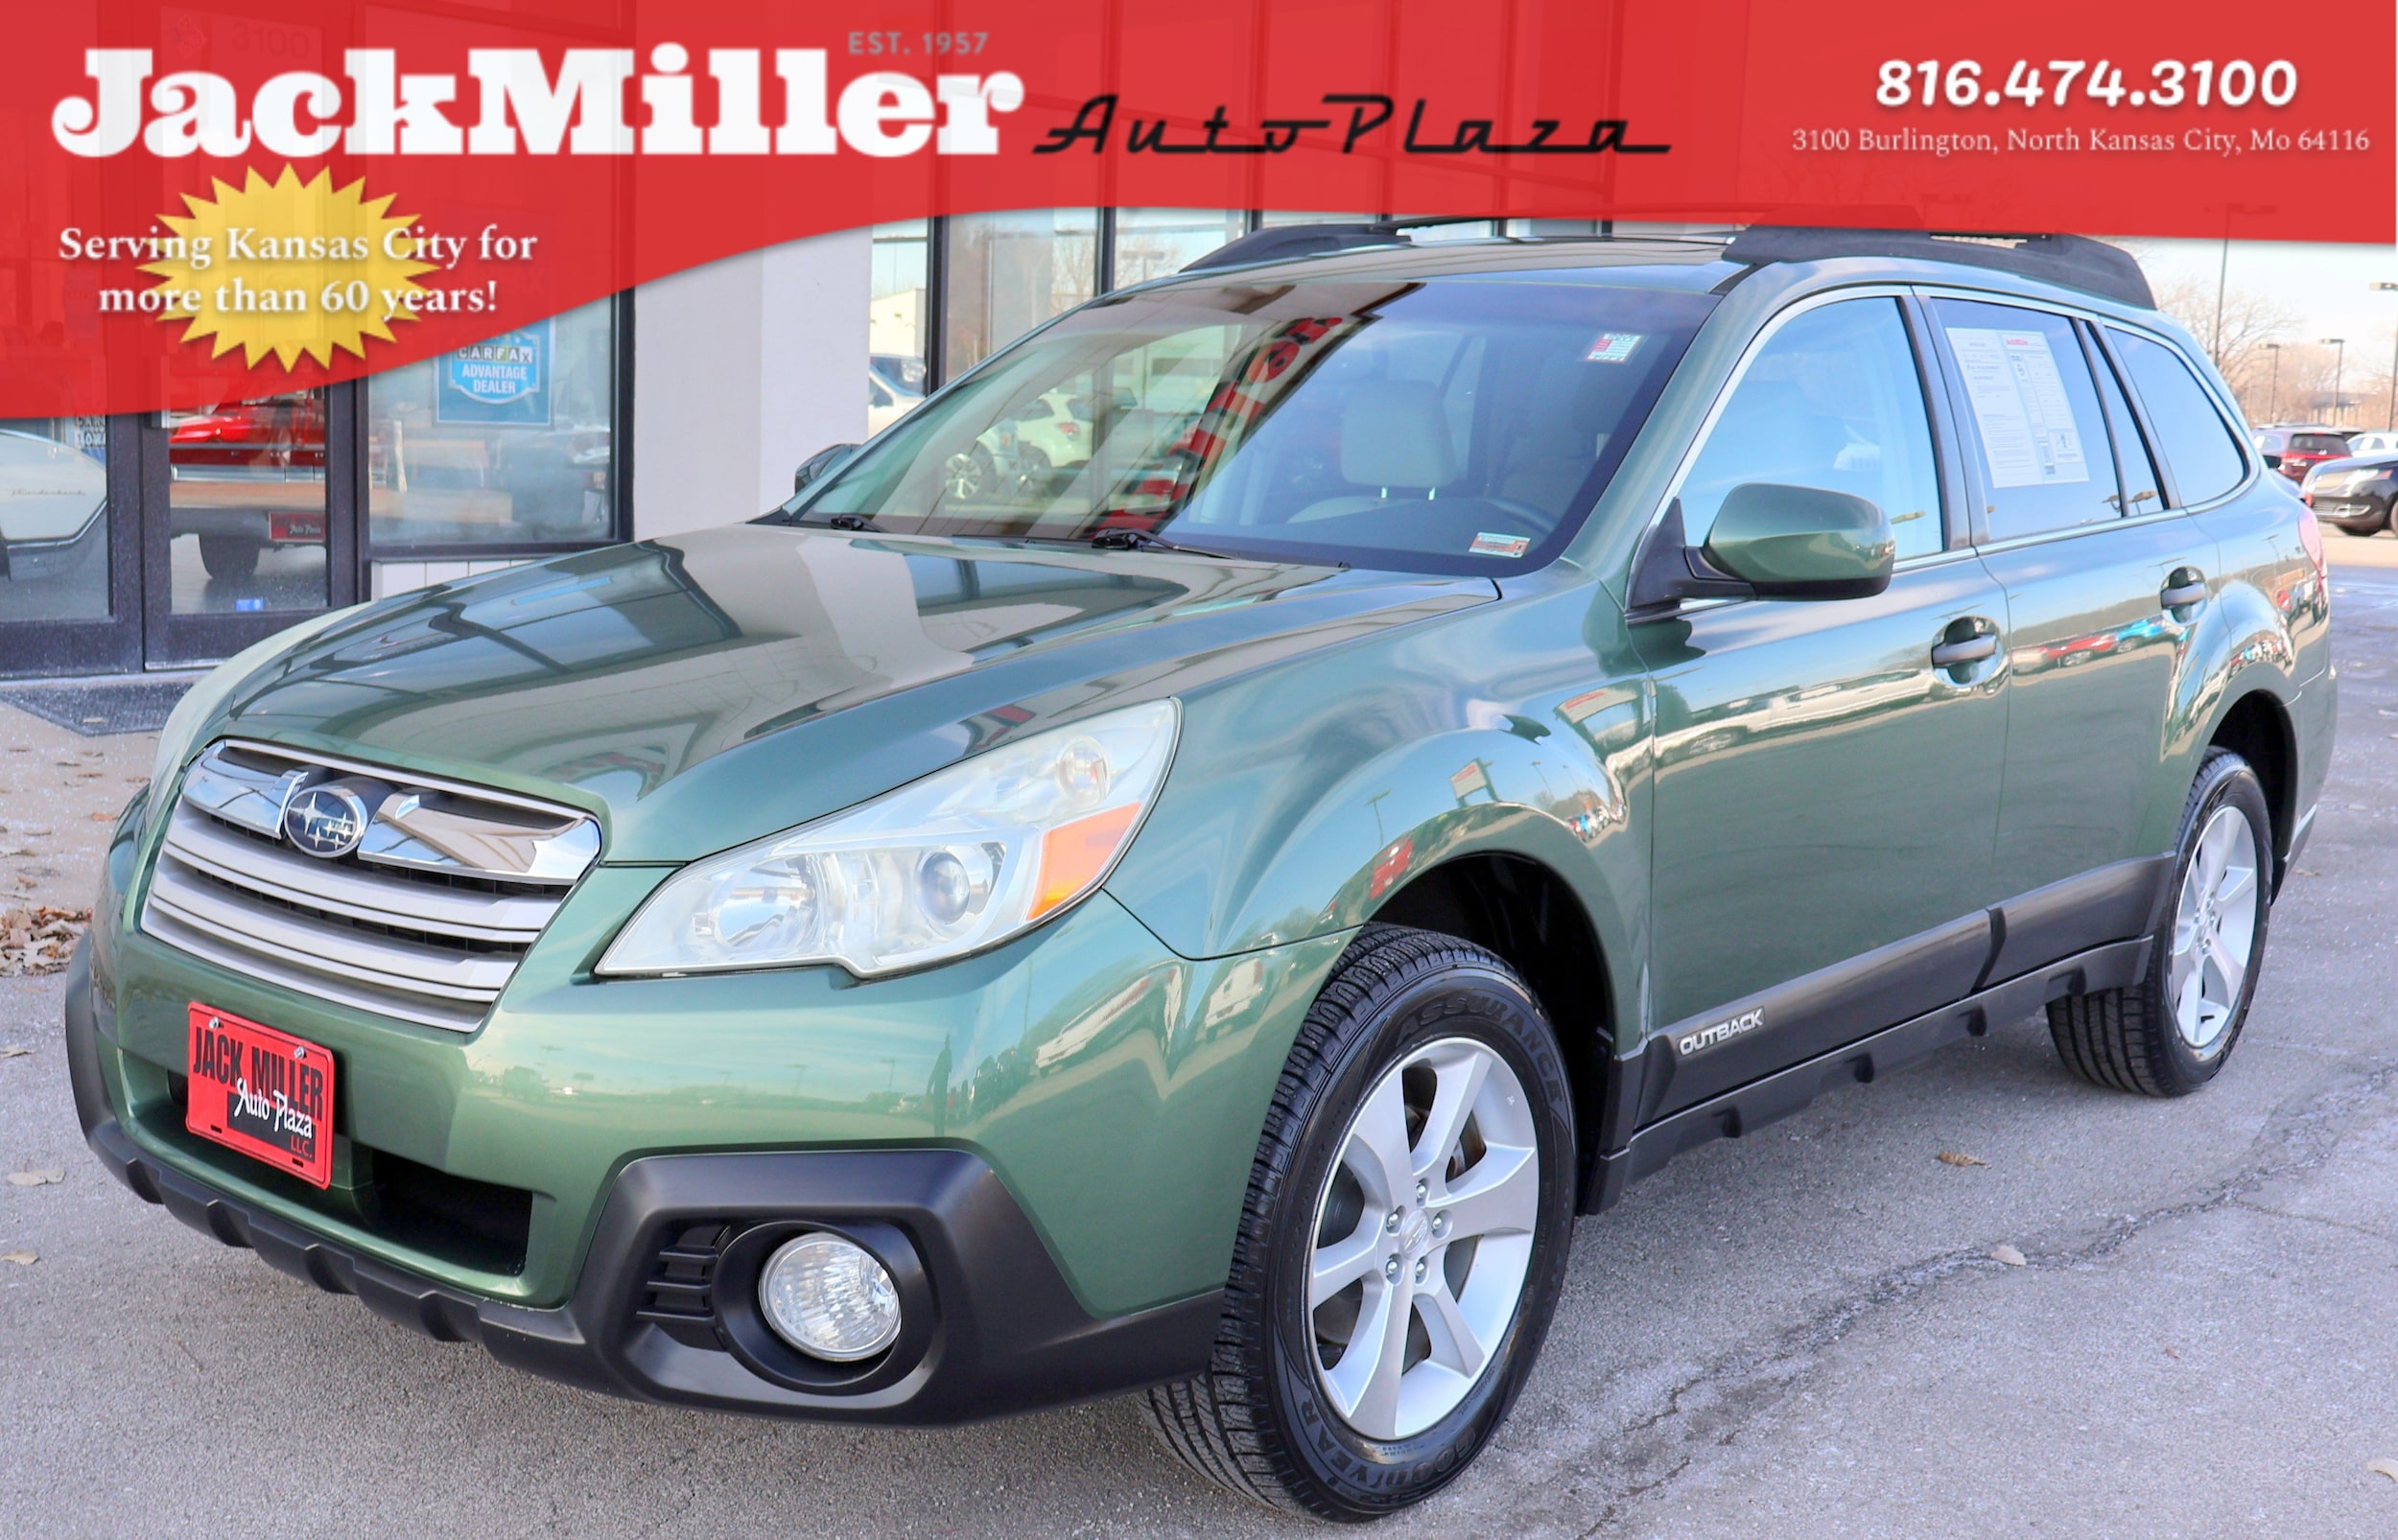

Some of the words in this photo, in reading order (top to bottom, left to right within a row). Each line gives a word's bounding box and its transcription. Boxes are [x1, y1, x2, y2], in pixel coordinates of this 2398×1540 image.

[457, 345, 533, 363] CARFAX
[461, 363, 528, 380] ADVANTAGE
[473, 379, 517, 394] DEALER
[1396, 994, 1563, 1103] ASSURANCE
[1679, 1008, 1764, 1056] OUTBACK
[193, 1026, 244, 1088] JACK
[251, 1046, 323, 1122] MILLER
[234, 1077, 270, 1121] Auto
[273, 1089, 313, 1139] Plaza
[290, 1134, 313, 1158] LLC.
[1301, 1397, 1476, 1489] GOODYEAR
